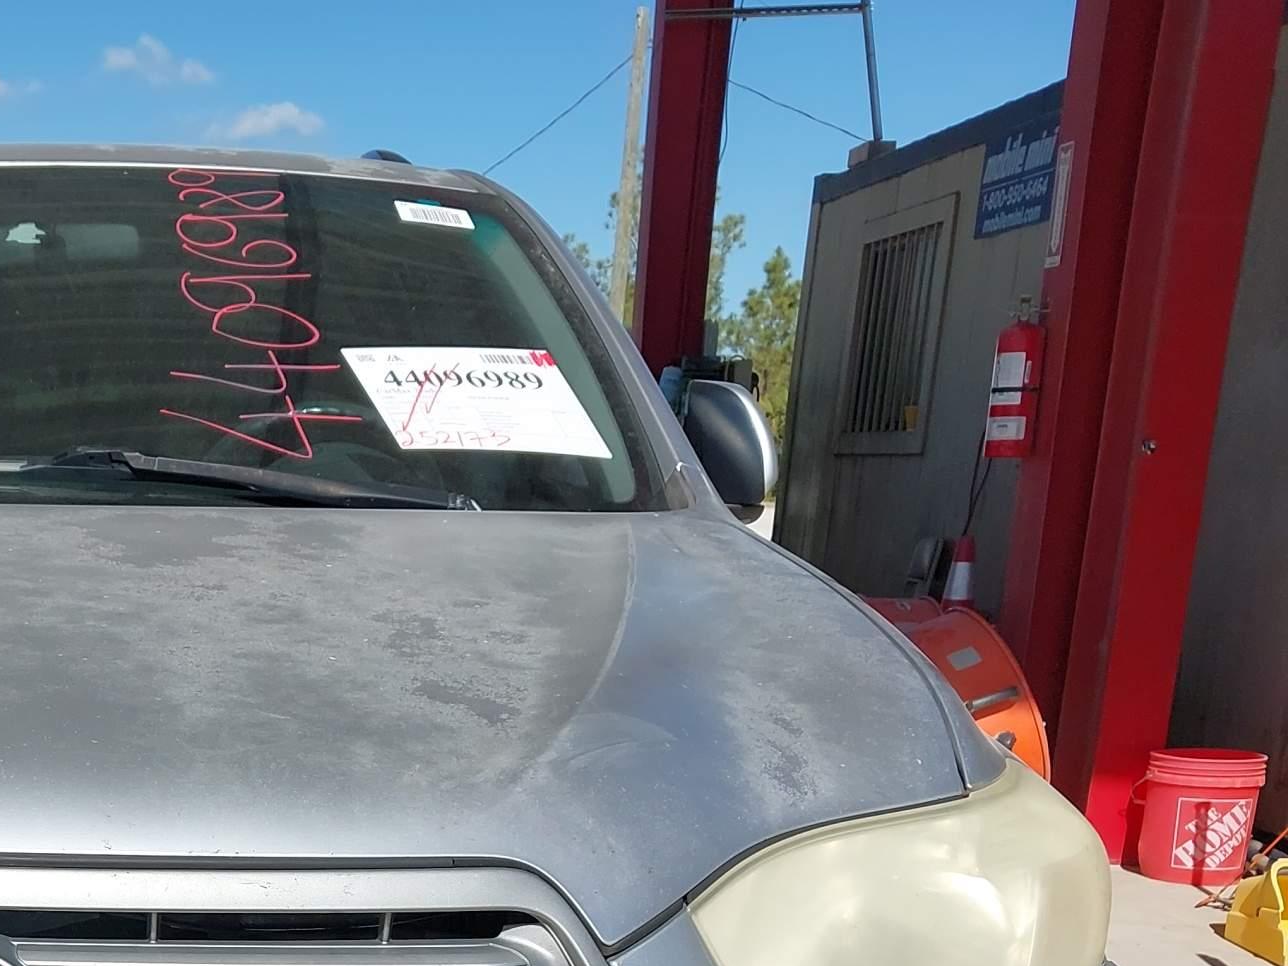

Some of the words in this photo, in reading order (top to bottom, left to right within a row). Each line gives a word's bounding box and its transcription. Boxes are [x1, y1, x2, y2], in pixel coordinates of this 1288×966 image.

[982, 133, 1027, 184] mobile
[159, 168, 362, 459] 44096989
[384, 369, 544, 390] 44096989
[1174, 801, 1250, 868] HOME
[1184, 807, 1222, 834] THE
[1205, 826, 1247, 868] DEPOT
